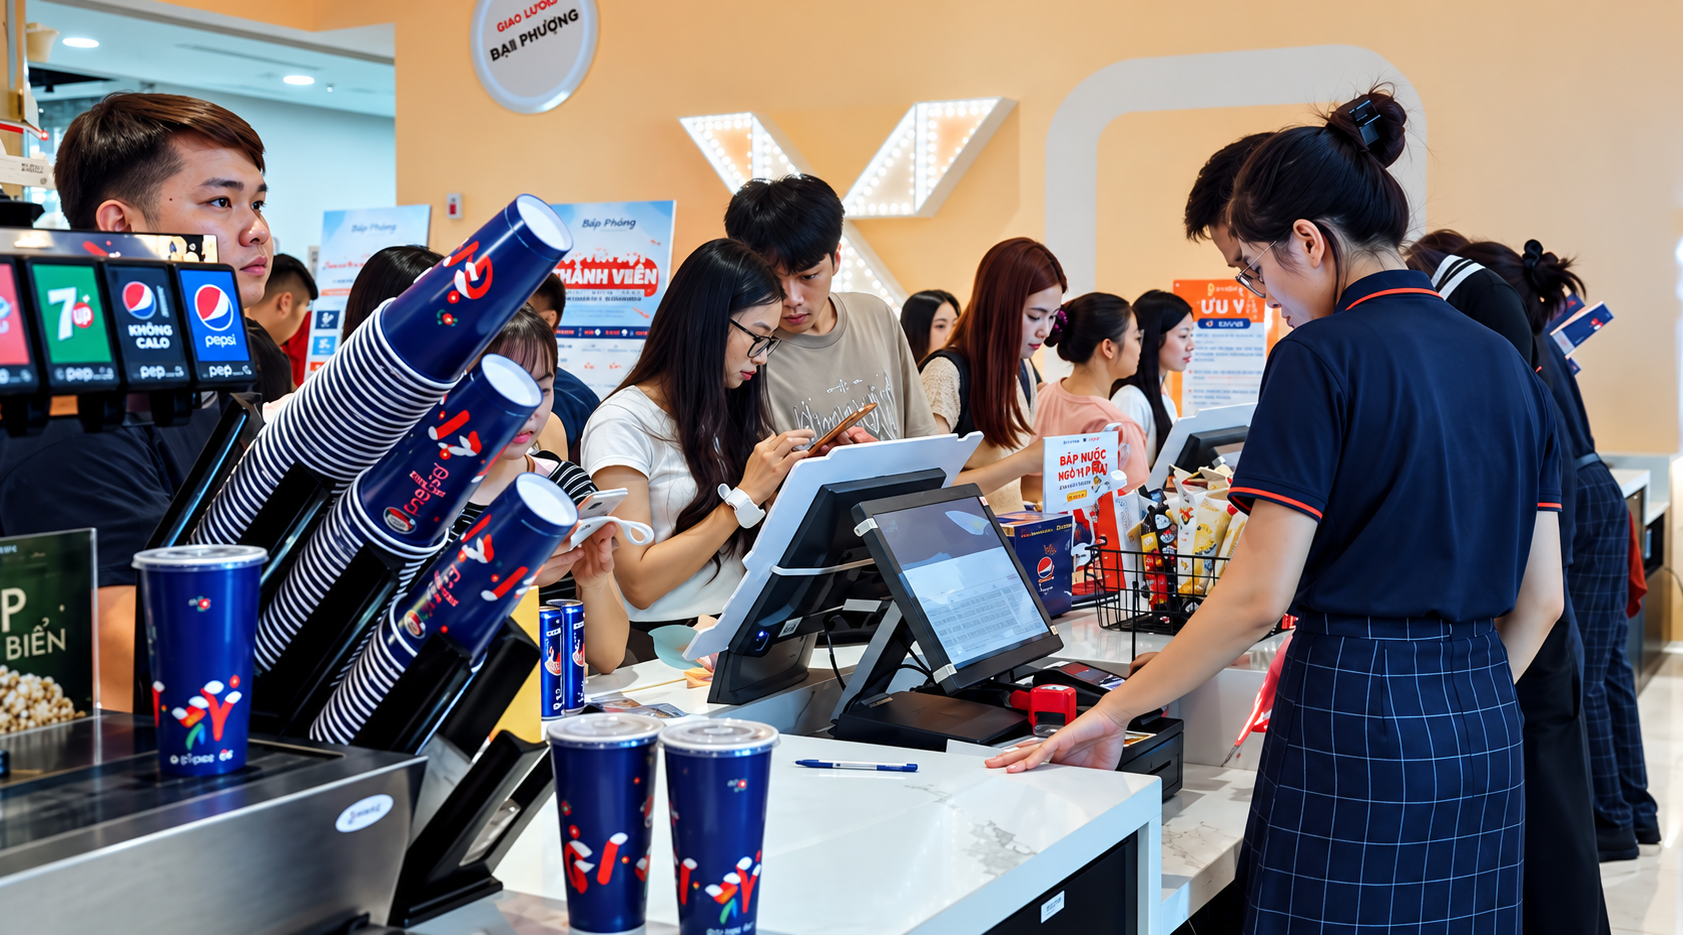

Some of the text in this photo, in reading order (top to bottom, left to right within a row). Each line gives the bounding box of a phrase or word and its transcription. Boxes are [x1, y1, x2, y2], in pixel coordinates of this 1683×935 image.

[128, 321, 173, 338] KHÔNG
[136, 337, 170, 349] CALO
[205, 334, 237, 348] pepsi
[6, 618, 66, 661] BIỂN
